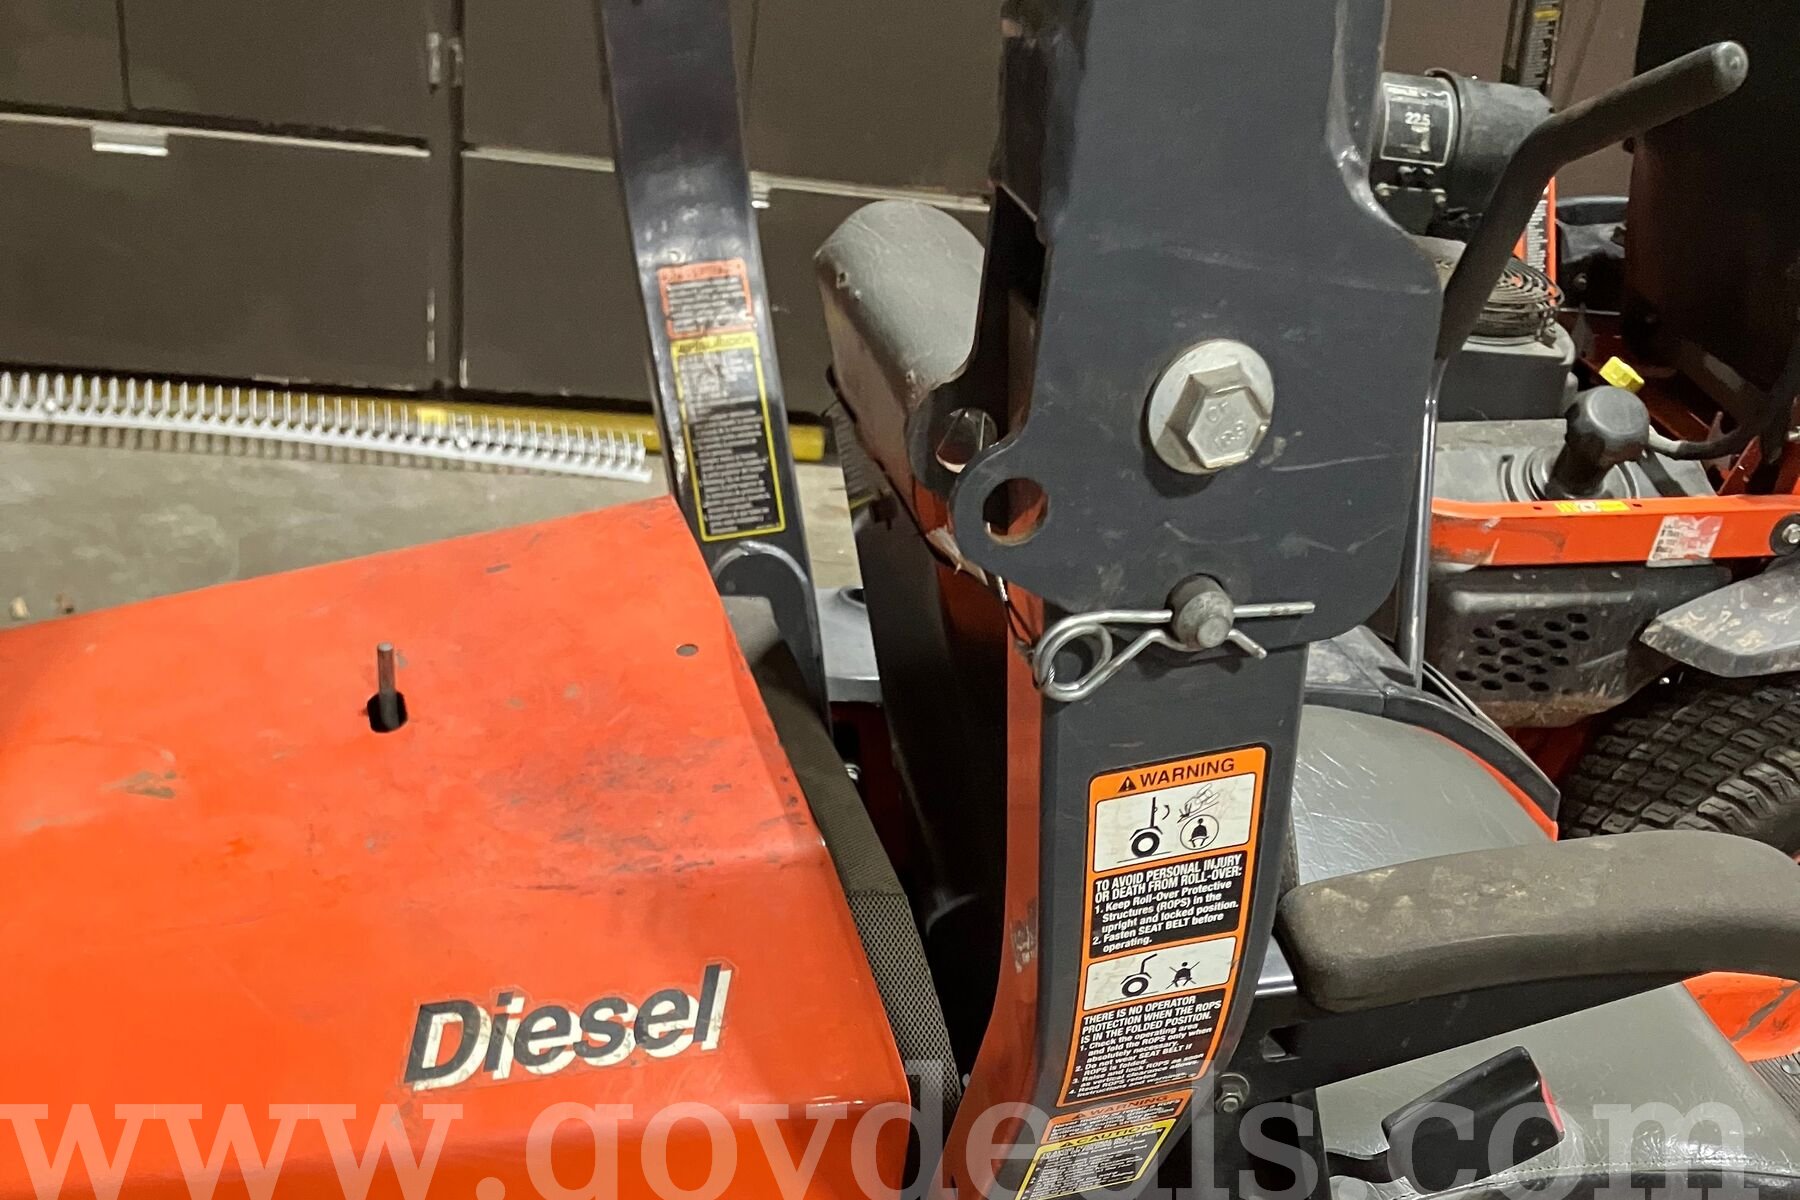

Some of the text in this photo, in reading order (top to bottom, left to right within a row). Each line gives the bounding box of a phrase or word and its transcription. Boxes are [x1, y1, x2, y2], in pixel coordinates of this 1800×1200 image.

[1140, 758, 1235, 787] WARNING
[1095, 866, 1242, 904] OR DEATH FROM ROLL-OVER:
[1096, 854, 1242, 892] TO AVOID PERSONAL INJURY
[1094, 880, 1232, 914] 1. Keep Roll-Over Protective
[1102, 893, 1222, 923] Structures (ROPS) in the
[1092, 913, 1224, 946] 2. Fasten SEAT BELT before
[1102, 901, 1239, 934] upright and locked position.
[1102, 936, 1152, 953] operating.
[1082, 1000, 1222, 1035] PROTECTION WHEN THE ROPS
[1084, 996, 1196, 1025] THERE IS NO OPERATOR
[403, 960, 735, 1091] Diesel
[1080, 1012, 1212, 1044] IS IN THE FOLDED POSITION.
[1088, 1038, 1116, 1050] Check
[1134, 1027, 1176, 1040] operating
[1178, 1024, 1198, 1032] area
[1088, 1028, 1212, 1056] and fold the ROPS only when
[1116, 1055, 1137, 1064] wear
[1138, 1050, 1161, 1059] SEAT
[1162, 1044, 1184, 1054] BELT
[1084, 1066, 1108, 1076] ROPS
[1086, 1050, 1132, 1064] absolutely
[1091, 1096, 1168, 1115] WARNING
[1076, 1124, 1152, 1143] CAUTION
